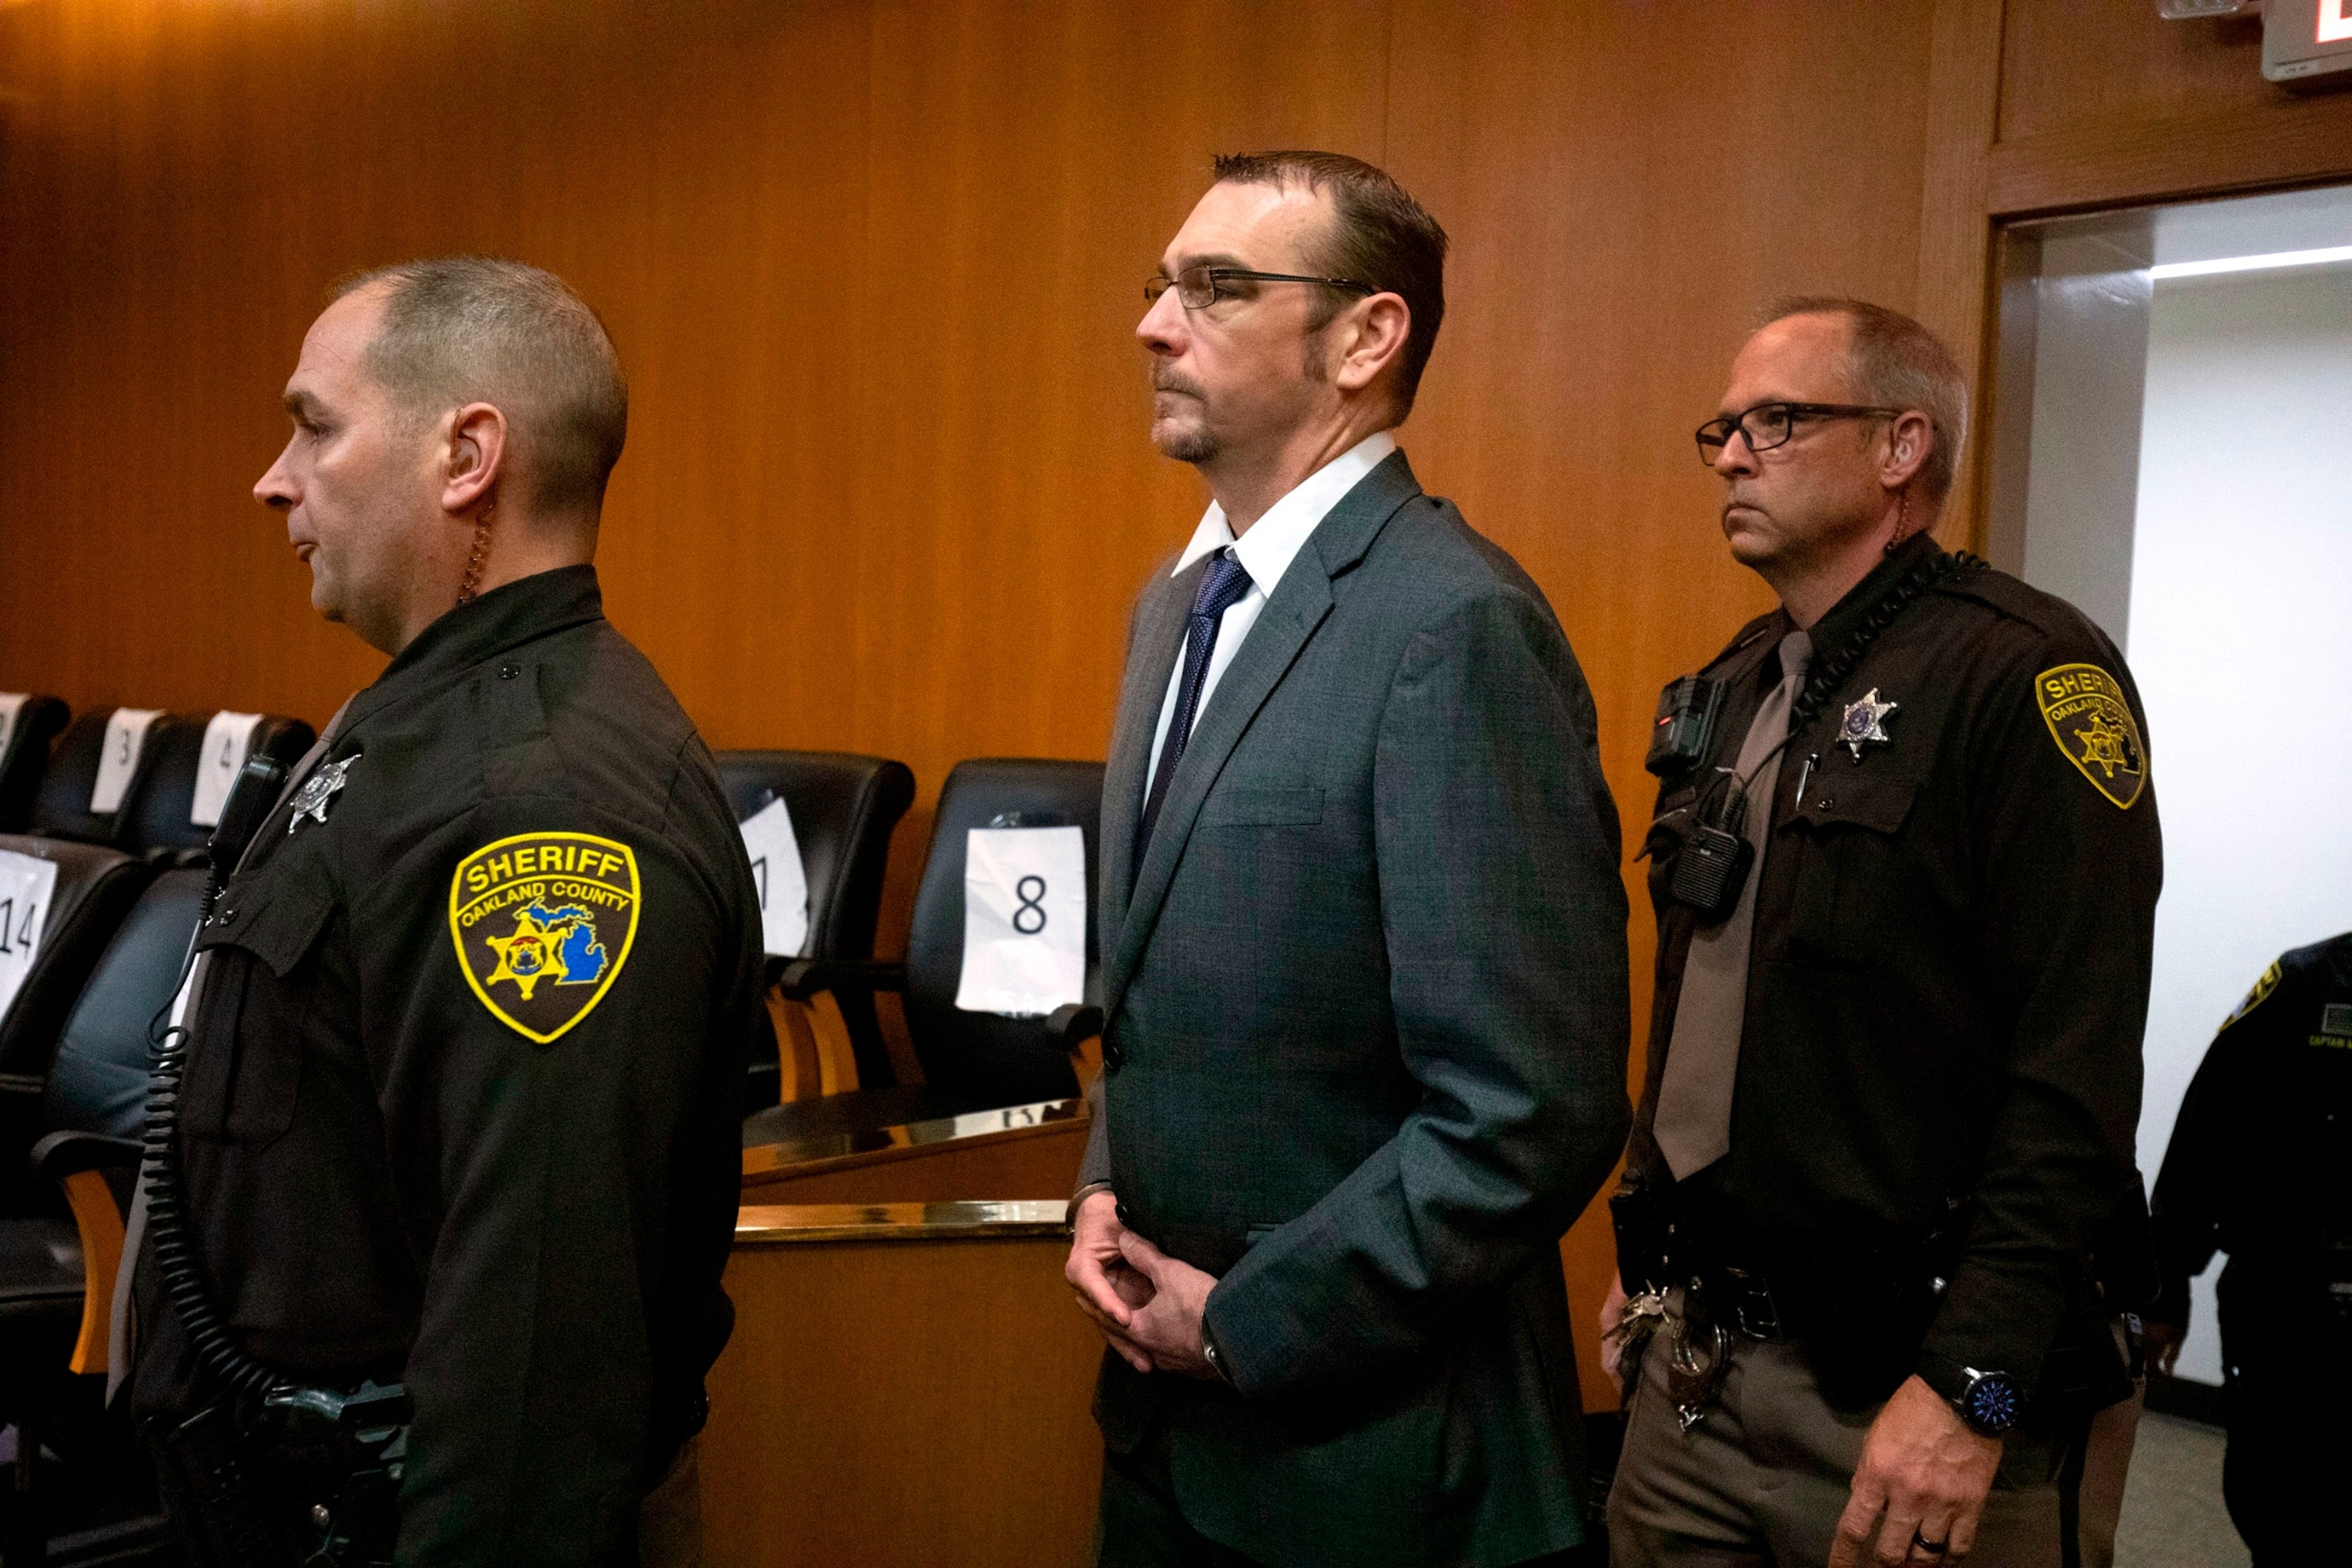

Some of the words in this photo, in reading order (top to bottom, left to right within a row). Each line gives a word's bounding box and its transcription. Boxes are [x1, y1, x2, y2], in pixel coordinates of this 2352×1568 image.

[2046, 673, 2118, 698] SHERI
[2052, 698, 2102, 721] OAKLAND
[466, 846, 624, 893] SHERIFF
[461, 882, 546, 927] OAKLAND
[551, 881, 630, 912] COUNTY
[1013, 875, 1047, 934] 8
[0, 897, 35, 961] 14
